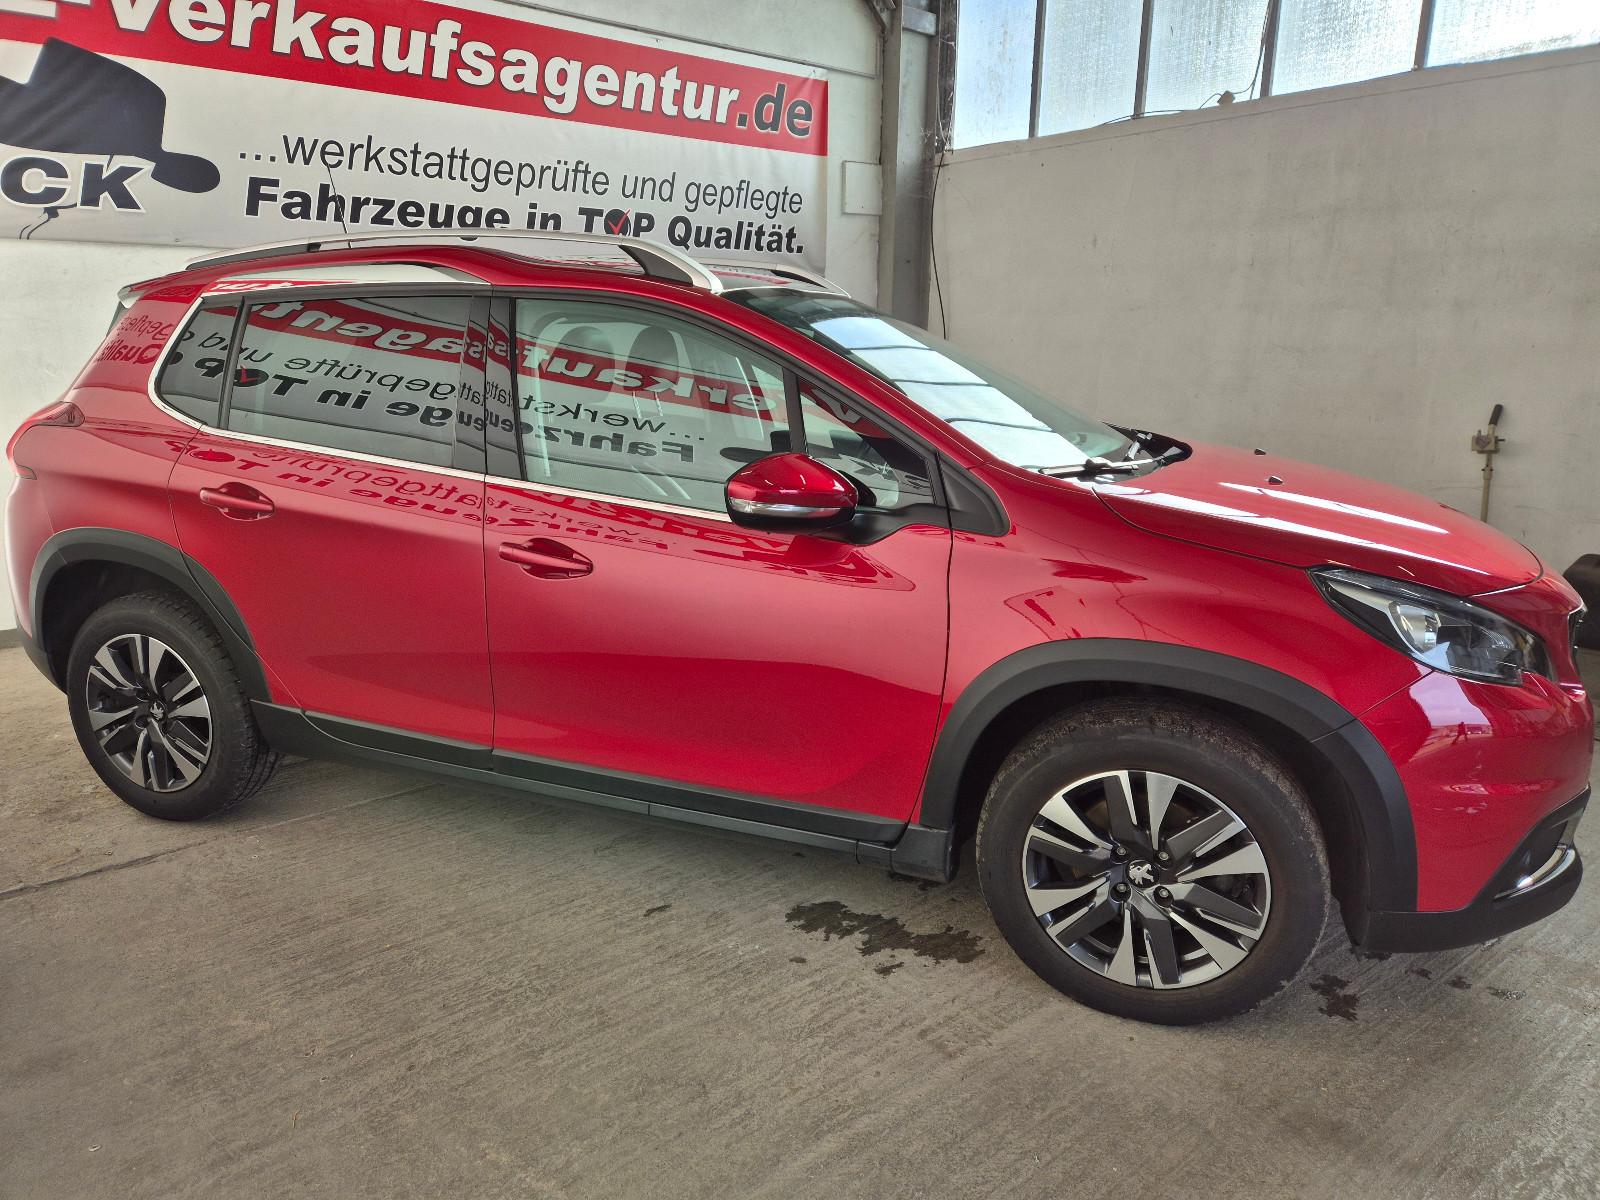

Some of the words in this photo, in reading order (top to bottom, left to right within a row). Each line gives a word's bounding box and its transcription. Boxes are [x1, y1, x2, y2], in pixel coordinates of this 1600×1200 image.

[0, 0, 813, 137] verkaufsagentur.de
[239, 134, 609, 196] ...werkstattgeprüfte
[621, 172, 676, 203] und
[684, 179, 803, 220] gepflegte
[244, 177, 510, 242] Fahrzeuge
[526, 202, 562, 231] in
[578, 207, 655, 238] TOP
[667, 215, 804, 254] Qualität.
